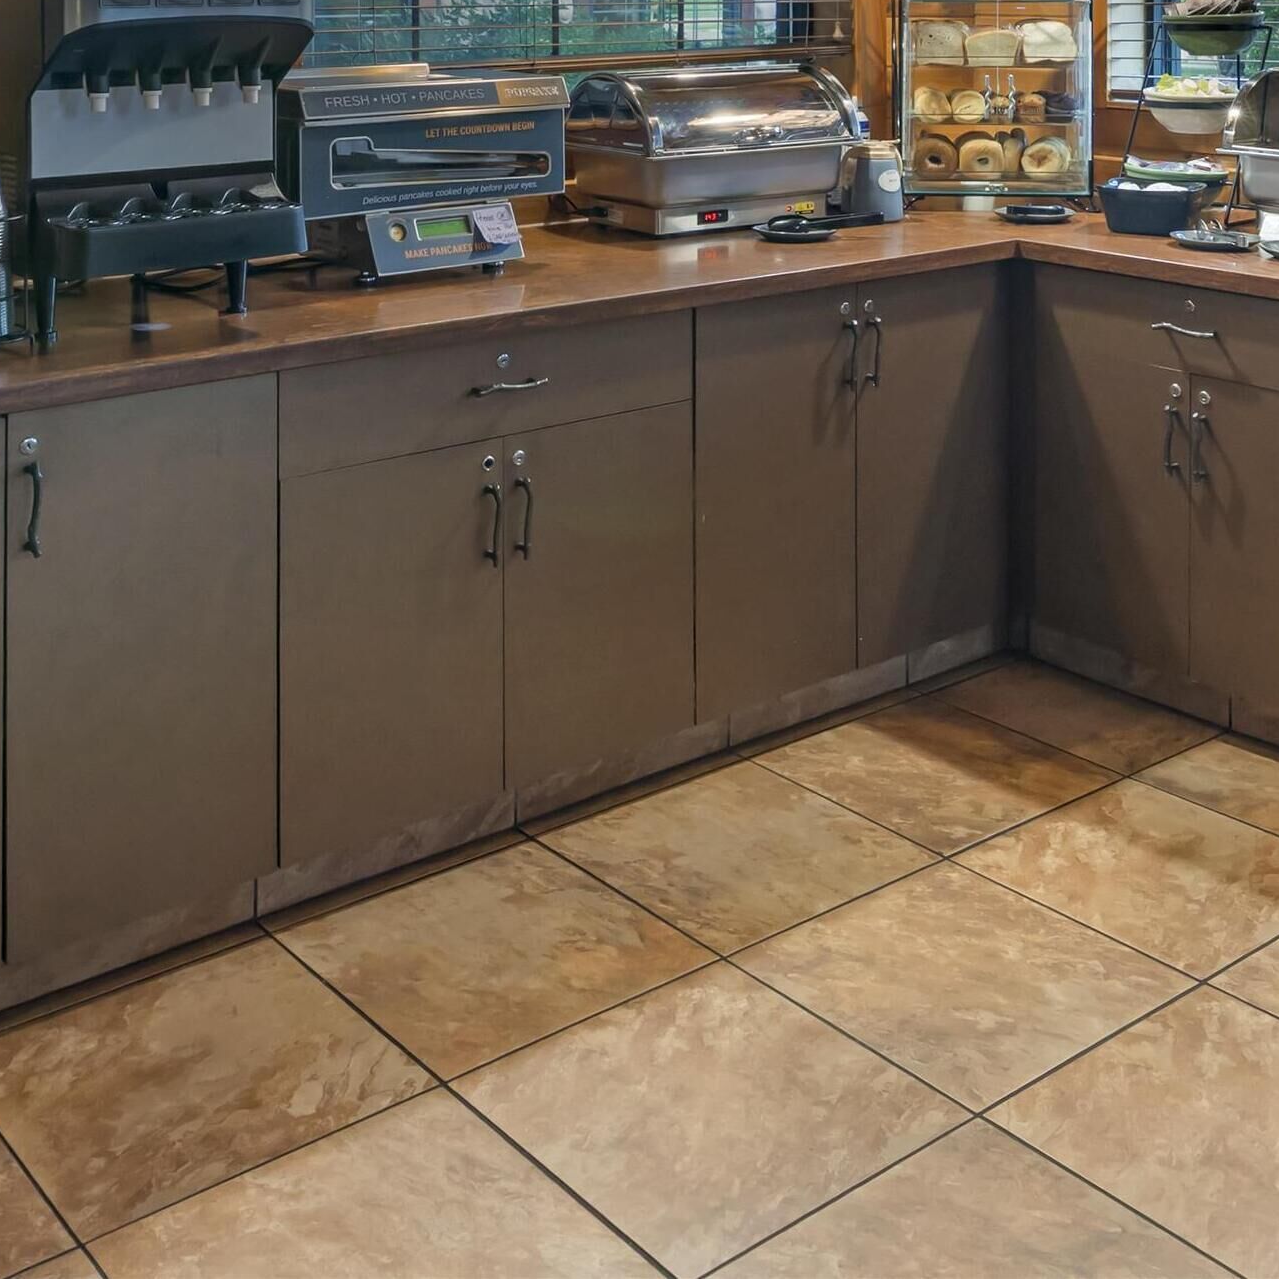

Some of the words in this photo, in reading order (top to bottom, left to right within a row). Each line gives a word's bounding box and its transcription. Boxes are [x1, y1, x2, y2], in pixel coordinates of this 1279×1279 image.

[324, 94, 370, 109] FRESH
[380, 91, 408, 105] HOT
[419, 88, 485, 102] PANCAKES
[425, 128, 440, 138] LET
[442, 127, 459, 137] THE
[460, 123, 511, 135] COUNTDOWN
[511, 121, 535, 132] BEGIN
[362, 194, 397, 205] Delicious
[398, 190, 433, 202] pancakes
[435, 186, 462, 197] cooked
[463, 184, 479, 195] right
[480, 183, 502, 194] before
[503, 184, 520, 193] your
[404, 247, 429, 259] MAKE
[430, 242, 473, 257] PANCAKES
